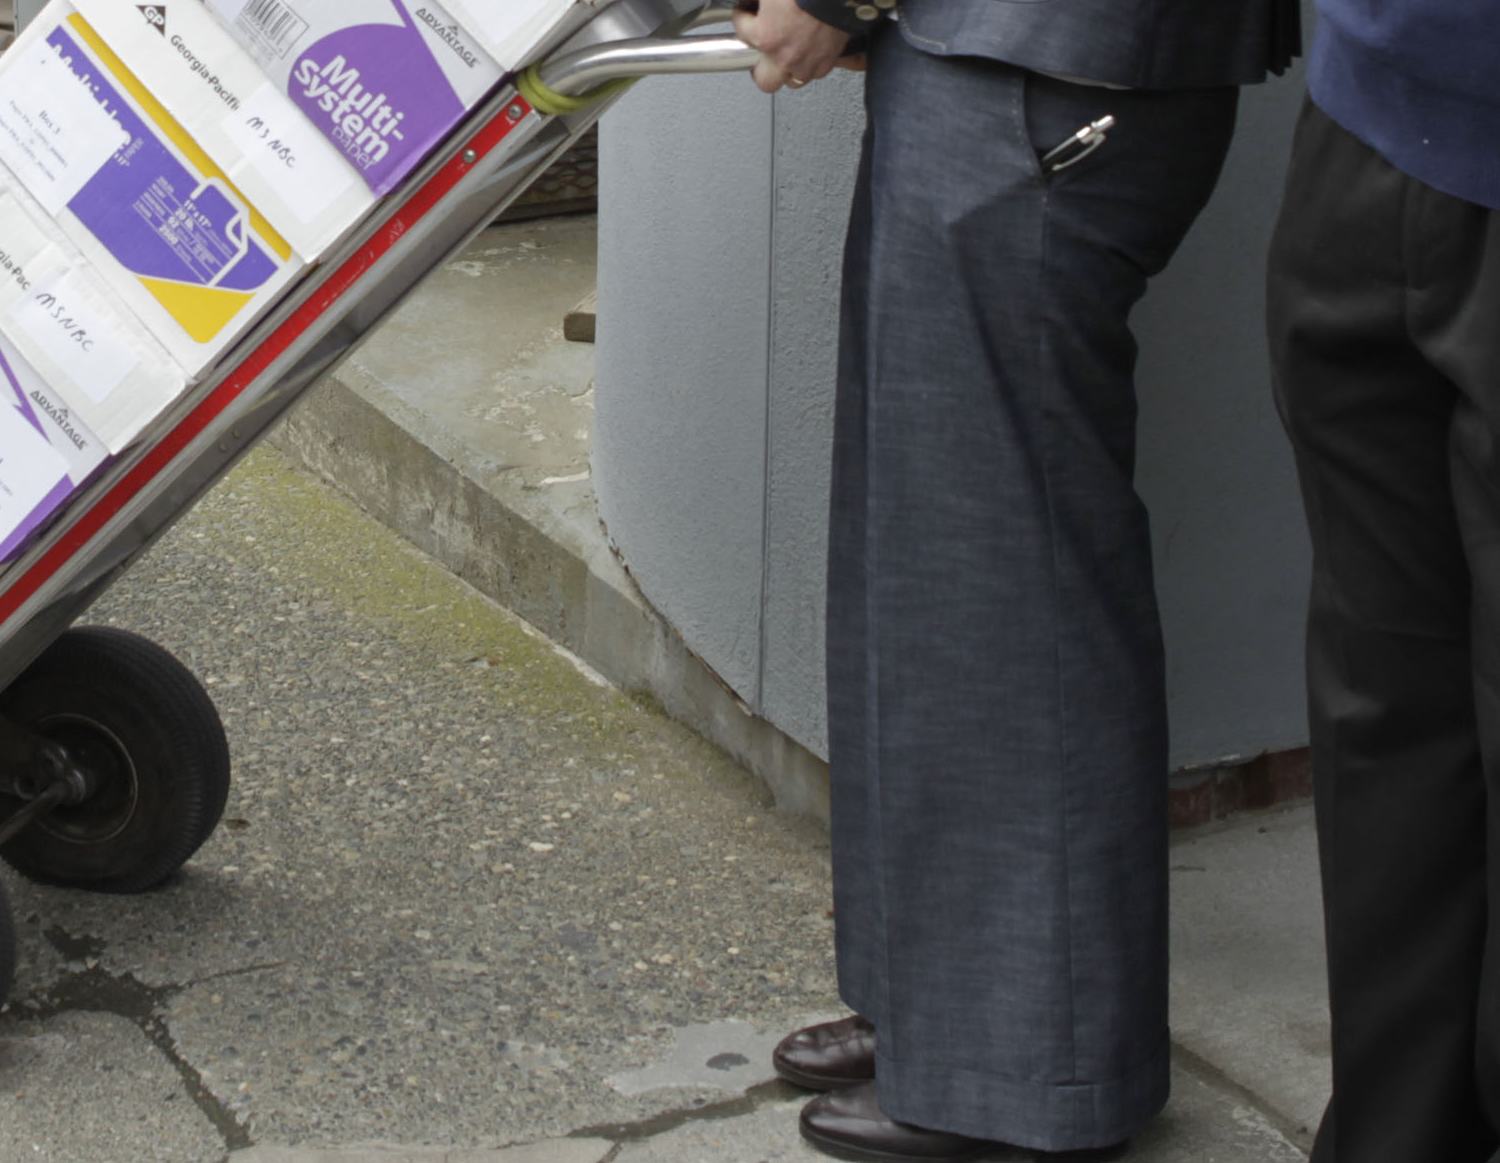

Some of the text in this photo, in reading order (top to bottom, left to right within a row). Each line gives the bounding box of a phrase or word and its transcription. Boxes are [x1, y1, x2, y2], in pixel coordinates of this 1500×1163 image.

[143, 6, 165, 26] GP
[415, 7, 477, 69] ADVANTAGE
[39, 110, 53, 129] Box
[294, 58, 389, 164] System
[320, 54, 405, 141] Multi-
[29, 390, 87, 451] ADVANTAGE
